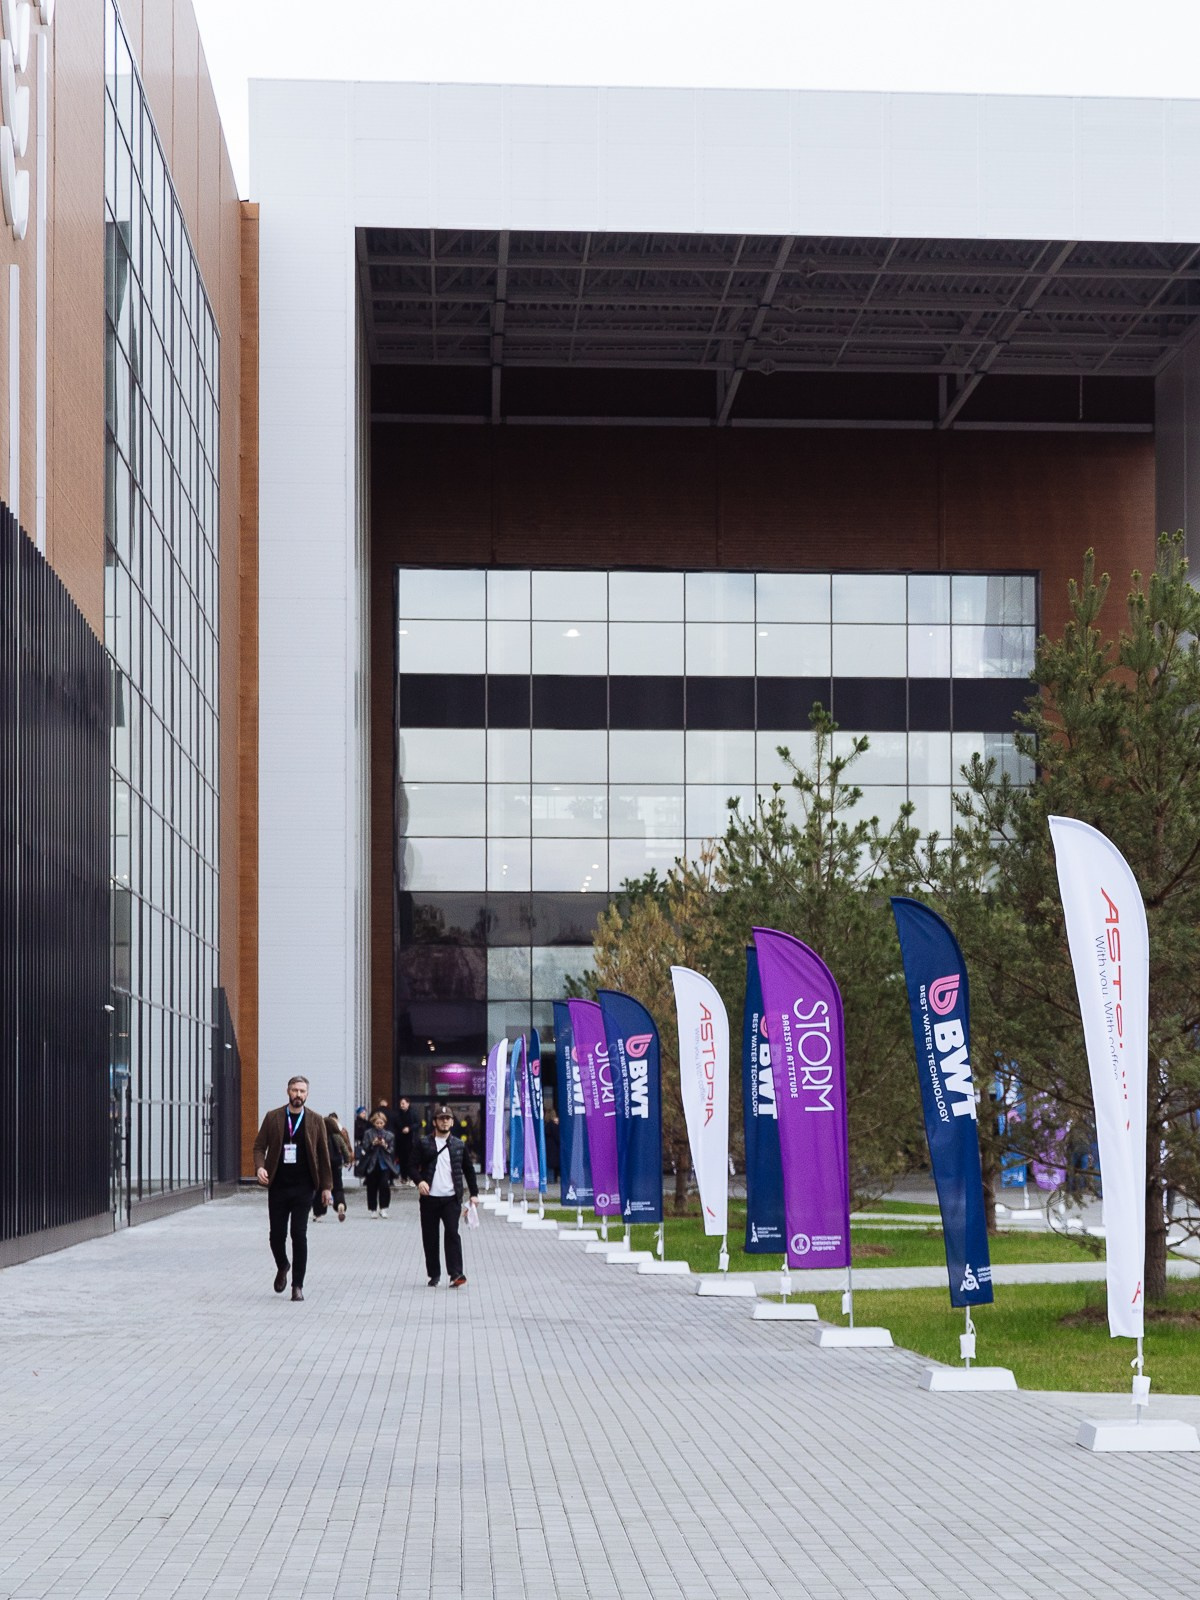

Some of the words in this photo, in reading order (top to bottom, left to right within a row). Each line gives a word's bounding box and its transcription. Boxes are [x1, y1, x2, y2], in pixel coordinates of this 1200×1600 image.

[919, 984, 928, 1012] BEST
[1095, 935, 1107, 967] With
[1104, 1001, 1114, 1033] With
[1100, 887, 1130, 1131] ASTO
[750, 1035, 758, 1063] WATER
[751, 1012, 759, 1036] BEST
[781, 1014, 793, 1053] BARISTA
[787, 1055, 799, 1099] ATTITUDE
[793, 997, 835, 1112] STORM
[922, 1013, 933, 1051] WATER
[628, 1059, 649, 1119] BWT
[750, 1063, 759, 1117] TECHNOLOGY
[927, 1052, 951, 1123] TECHNOLOGY
[933, 1018, 977, 1120] BWT
